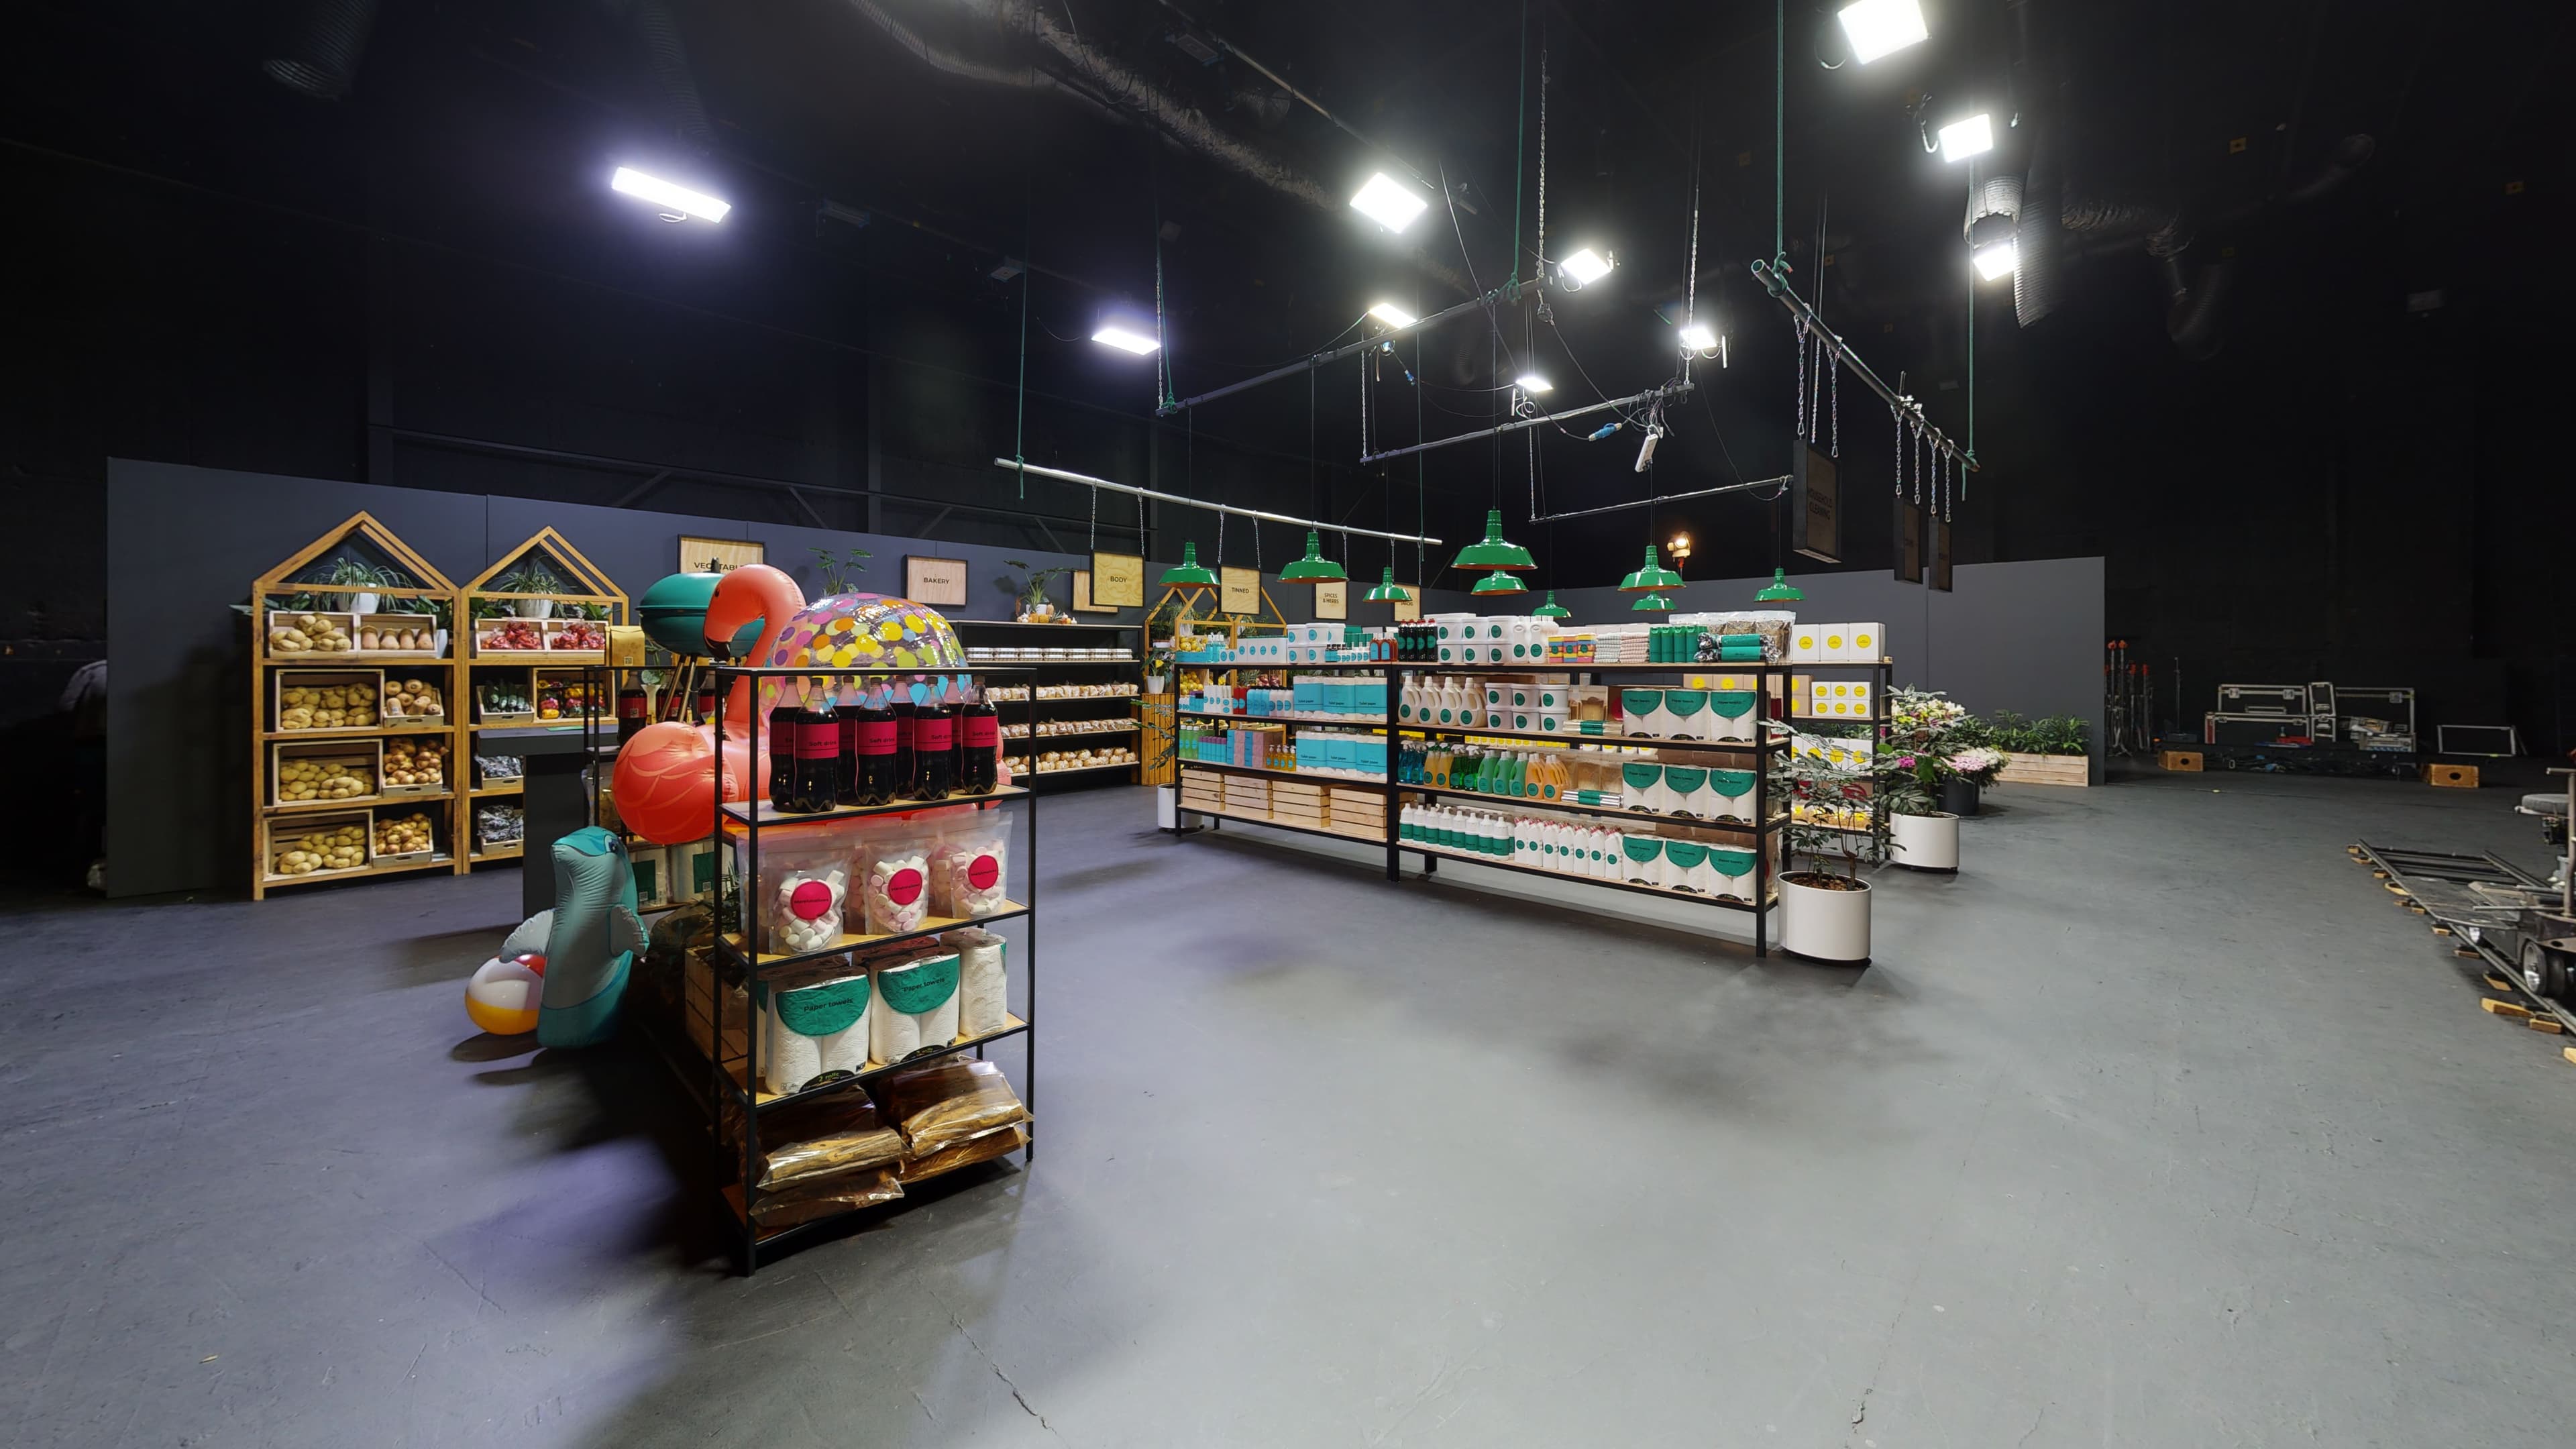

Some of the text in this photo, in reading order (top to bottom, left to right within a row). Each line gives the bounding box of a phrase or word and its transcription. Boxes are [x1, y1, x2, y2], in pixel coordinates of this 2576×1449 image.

[902, 977, 945, 992] Paper towels
[804, 998, 854, 1012] Paper towels
